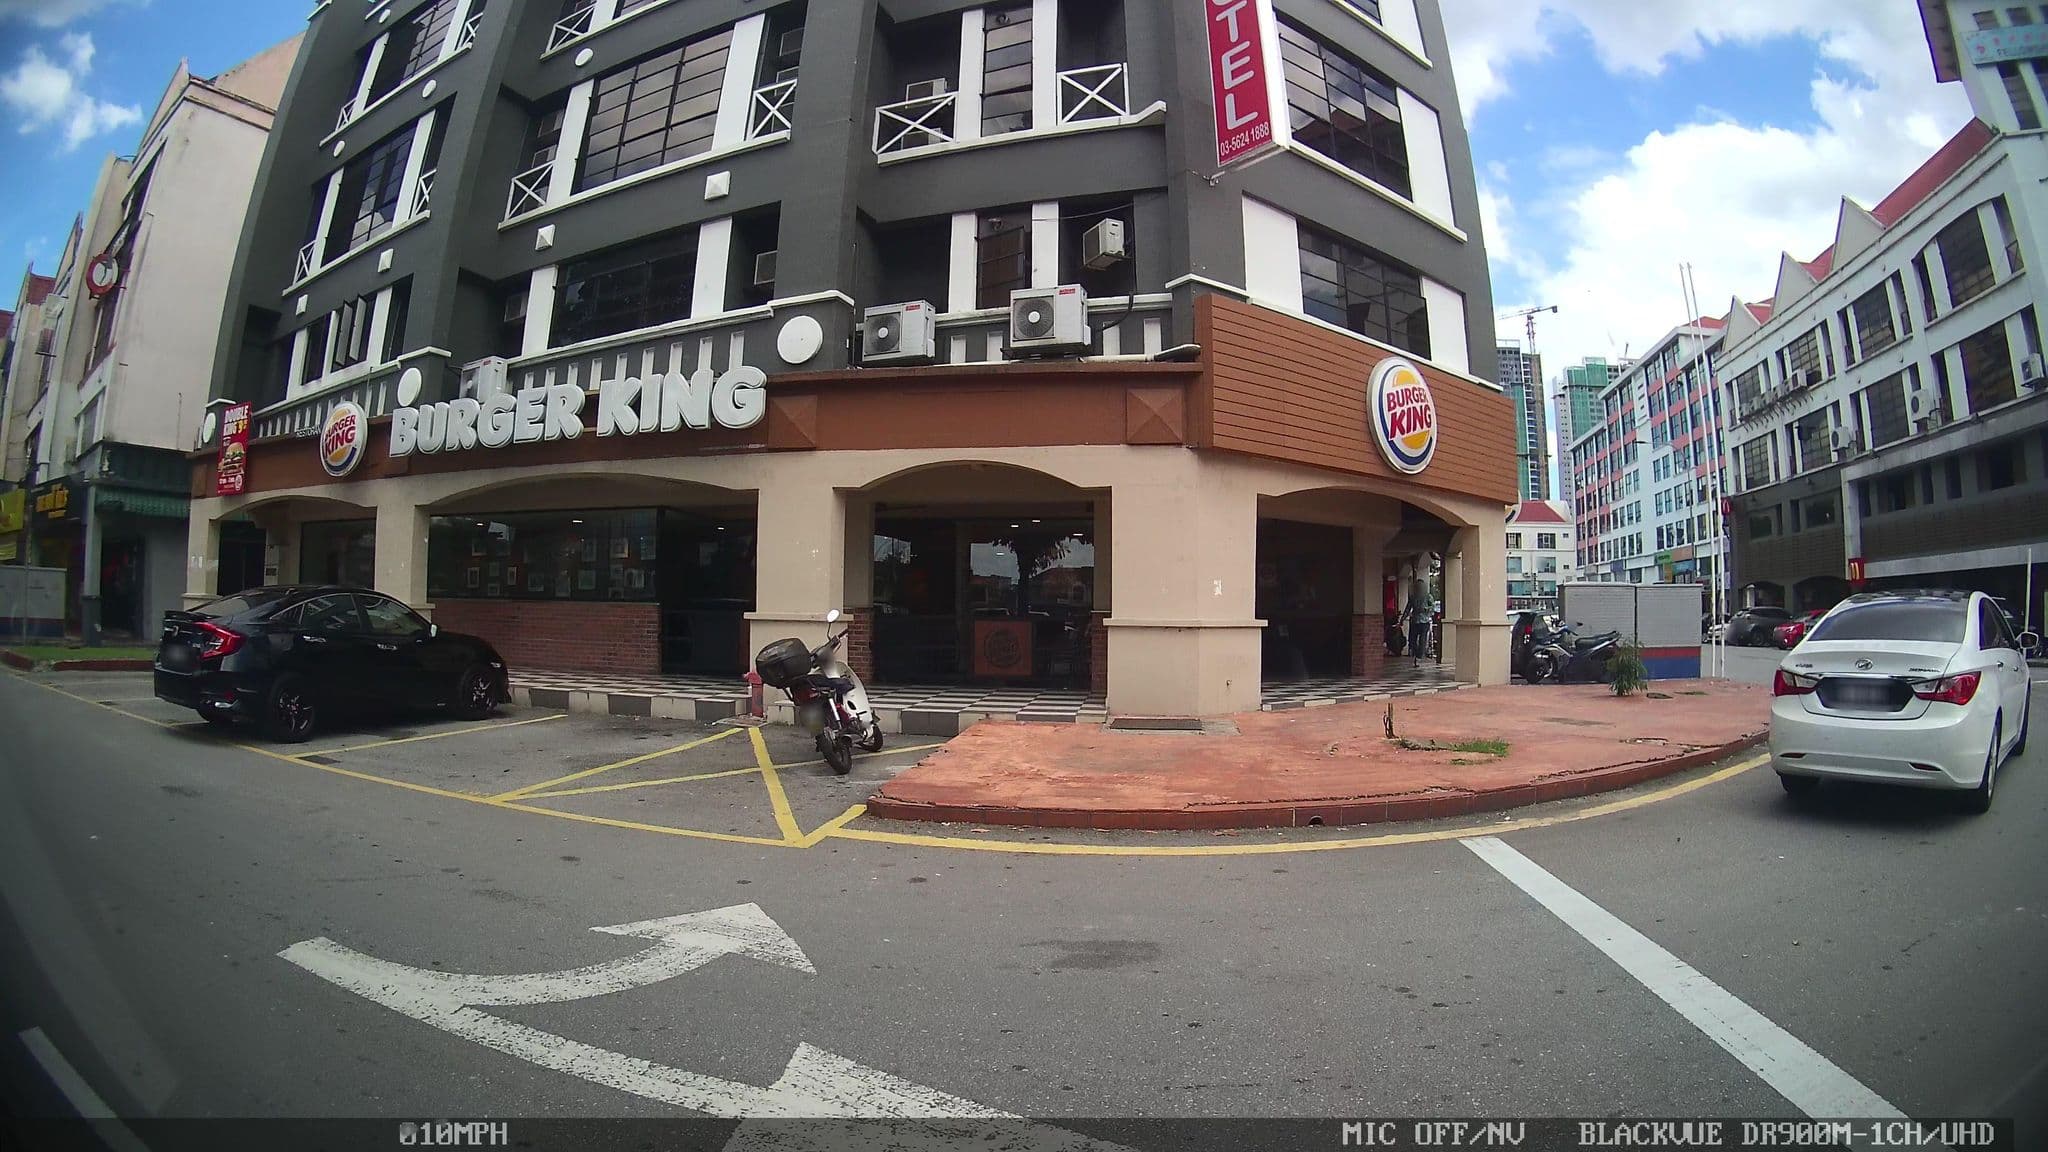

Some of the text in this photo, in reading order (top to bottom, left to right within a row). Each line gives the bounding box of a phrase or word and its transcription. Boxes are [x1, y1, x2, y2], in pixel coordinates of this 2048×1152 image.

[1211, 0, 1259, 130] TEL
[1220, 122, 1270, 156] 03-5624 1888
[389, 366, 768, 457] BURGER KING
[1386, 387, 1429, 412] BURGER
[325, 415, 356, 441] BURGER
[1390, 404, 1432, 439] KING
[325, 426, 356, 458] KING
